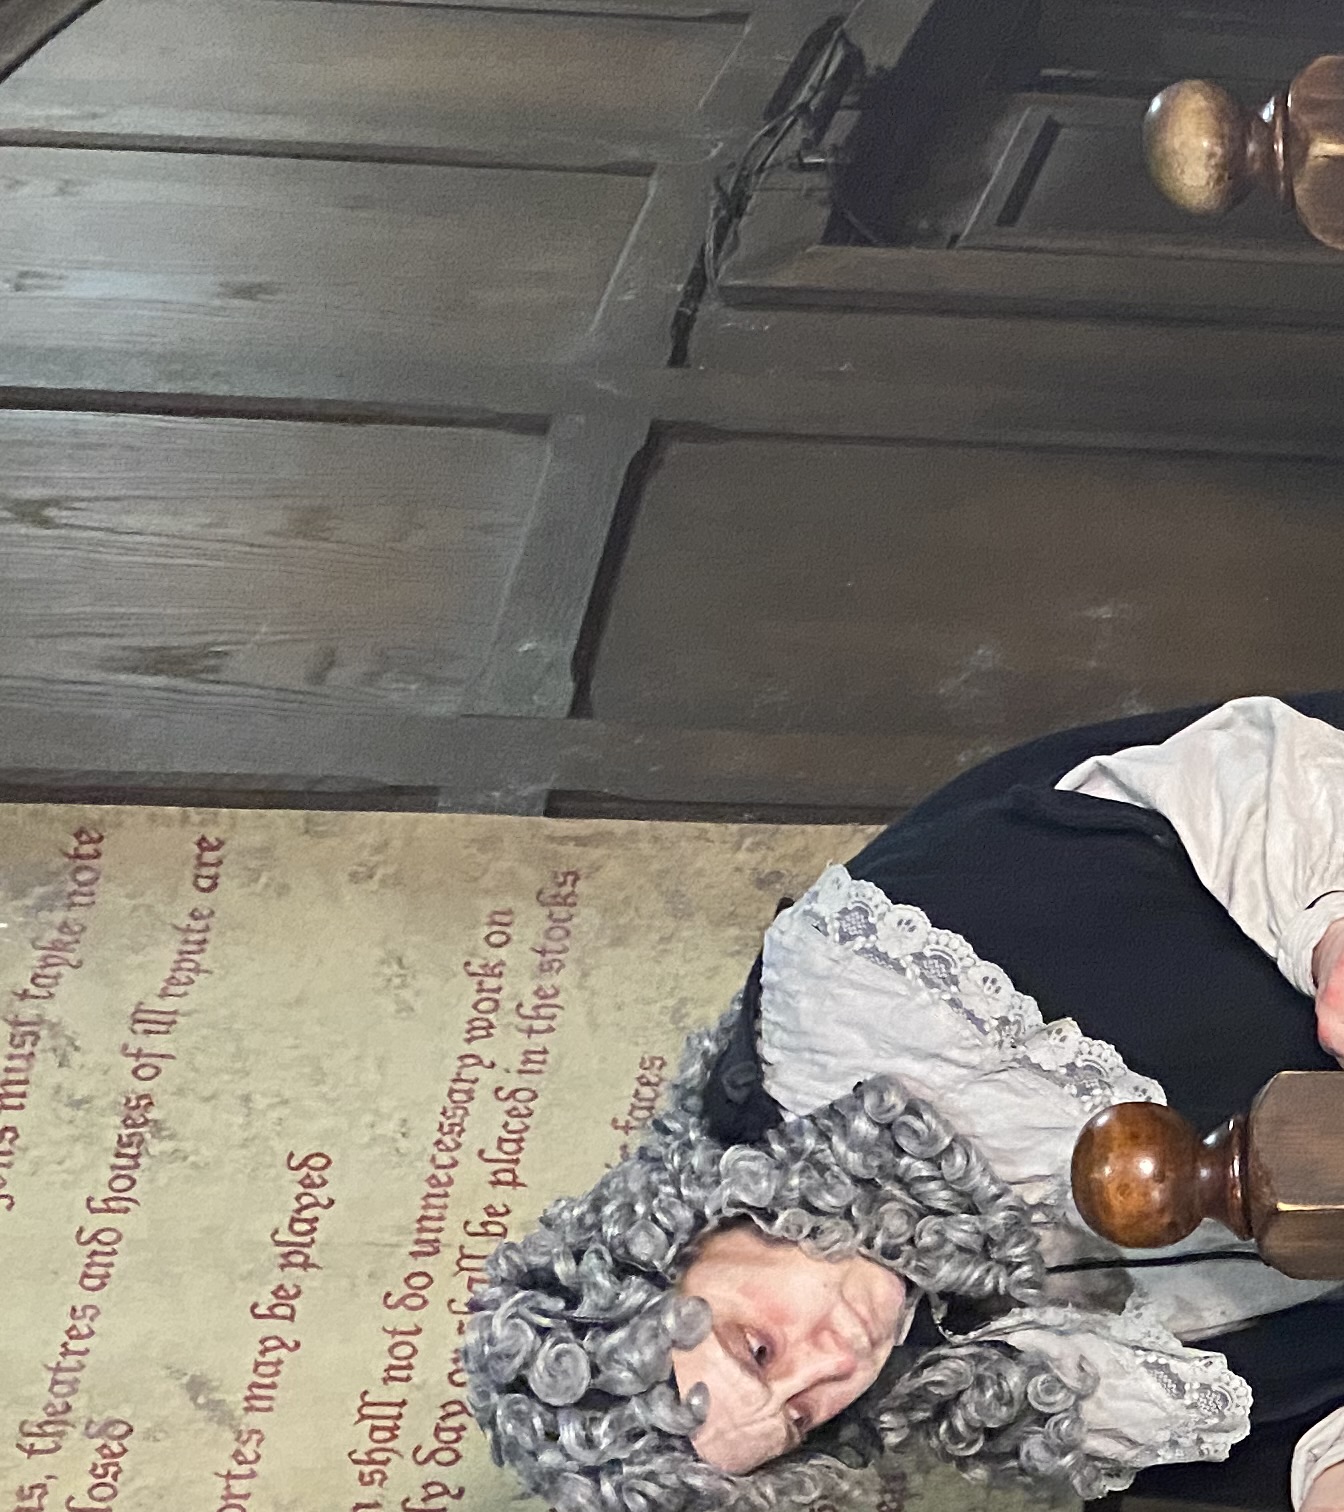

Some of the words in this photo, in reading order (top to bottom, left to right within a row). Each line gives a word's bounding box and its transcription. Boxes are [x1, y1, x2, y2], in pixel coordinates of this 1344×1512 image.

[61, 825, 104, 911] note
[190, 834, 225, 893] are
[156, 907, 214, 998] repute
[482, 908, 515, 949] on
[529, 869, 581, 976] stocks
[11, 923, 83, 1001] tayke
[128, 1003, 179, 1035] ill
[463, 959, 507, 1045] work
[515, 985, 564, 1039] the
[0, 1014, 43, 1111] must
[120, 1044, 176, 1081] of
[505, 1046, 550, 1076] in
[610, 1055, 667, 1136] faces
[86, 1093, 154, 1214] houses
[406, 1053, 495, 1260] unnecessary
[477, 1086, 538, 1189] placed
[270, 1151, 335, 1271] played
[463, 1203, 511, 1238] be
[75, 1226, 123, 1292] and
[382, 1271, 434, 1312] do
[250, 1283, 302, 1322] be
[15, 1304, 100, 1459] theatres
[242, 1335, 300, 1413] may
[380, 1324, 423, 1385] not
[347, 1390, 408, 1487] shall
[411, 1399, 471, 1467] day
